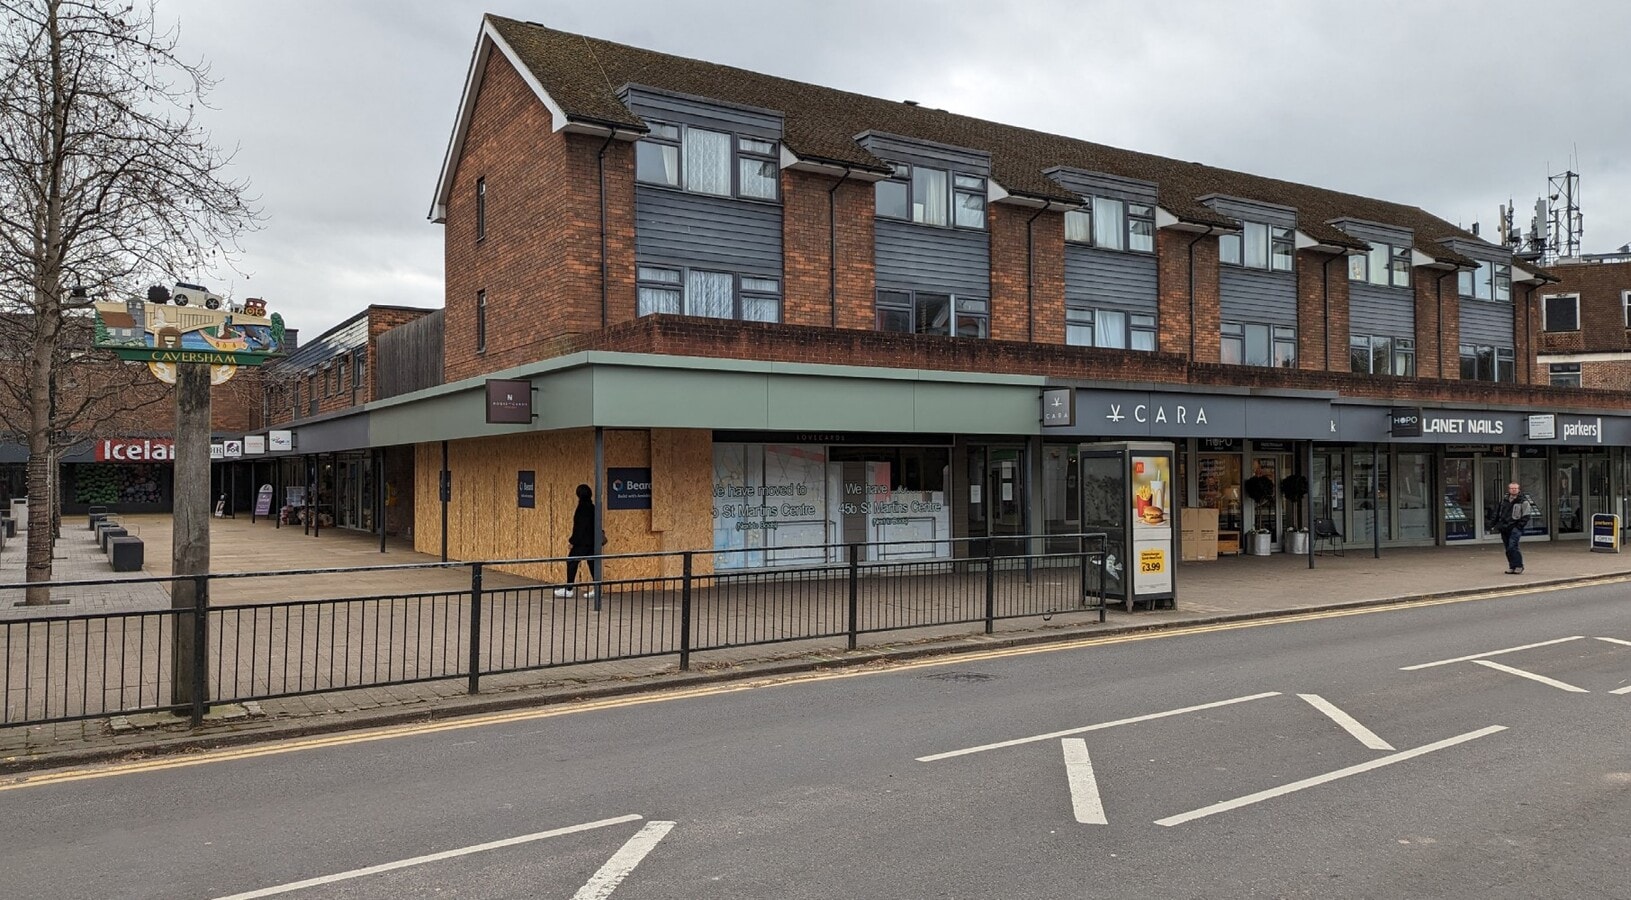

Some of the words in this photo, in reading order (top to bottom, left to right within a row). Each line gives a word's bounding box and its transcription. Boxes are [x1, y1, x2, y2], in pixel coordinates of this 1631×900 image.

[151, 351, 237, 364] CAVERSHAM
[1045, 412, 1069, 420] CARA
[1134, 404, 1208, 424] CARA
[1393, 416, 1418, 424] HOPO
[1468, 419, 1504, 435] NAILS
[1563, 420, 1597, 441] parkers
[104, 440, 175, 460] Icela
[727, 483, 755, 497] have
[758, 482, 794, 496] moved
[796, 483, 808, 495] to
[845, 483, 862, 495] We
[865, 482, 888, 495] have
[722, 504, 736, 518] St
[738, 503, 778, 517] Martins
[781, 503, 816, 516] Centre
[838, 502, 857, 514] 45b
[860, 501, 872, 514] St
[874, 500, 908, 514] Martins
[911, 500, 942, 512] Centre
[1142, 562, 1161, 572] £3.99
